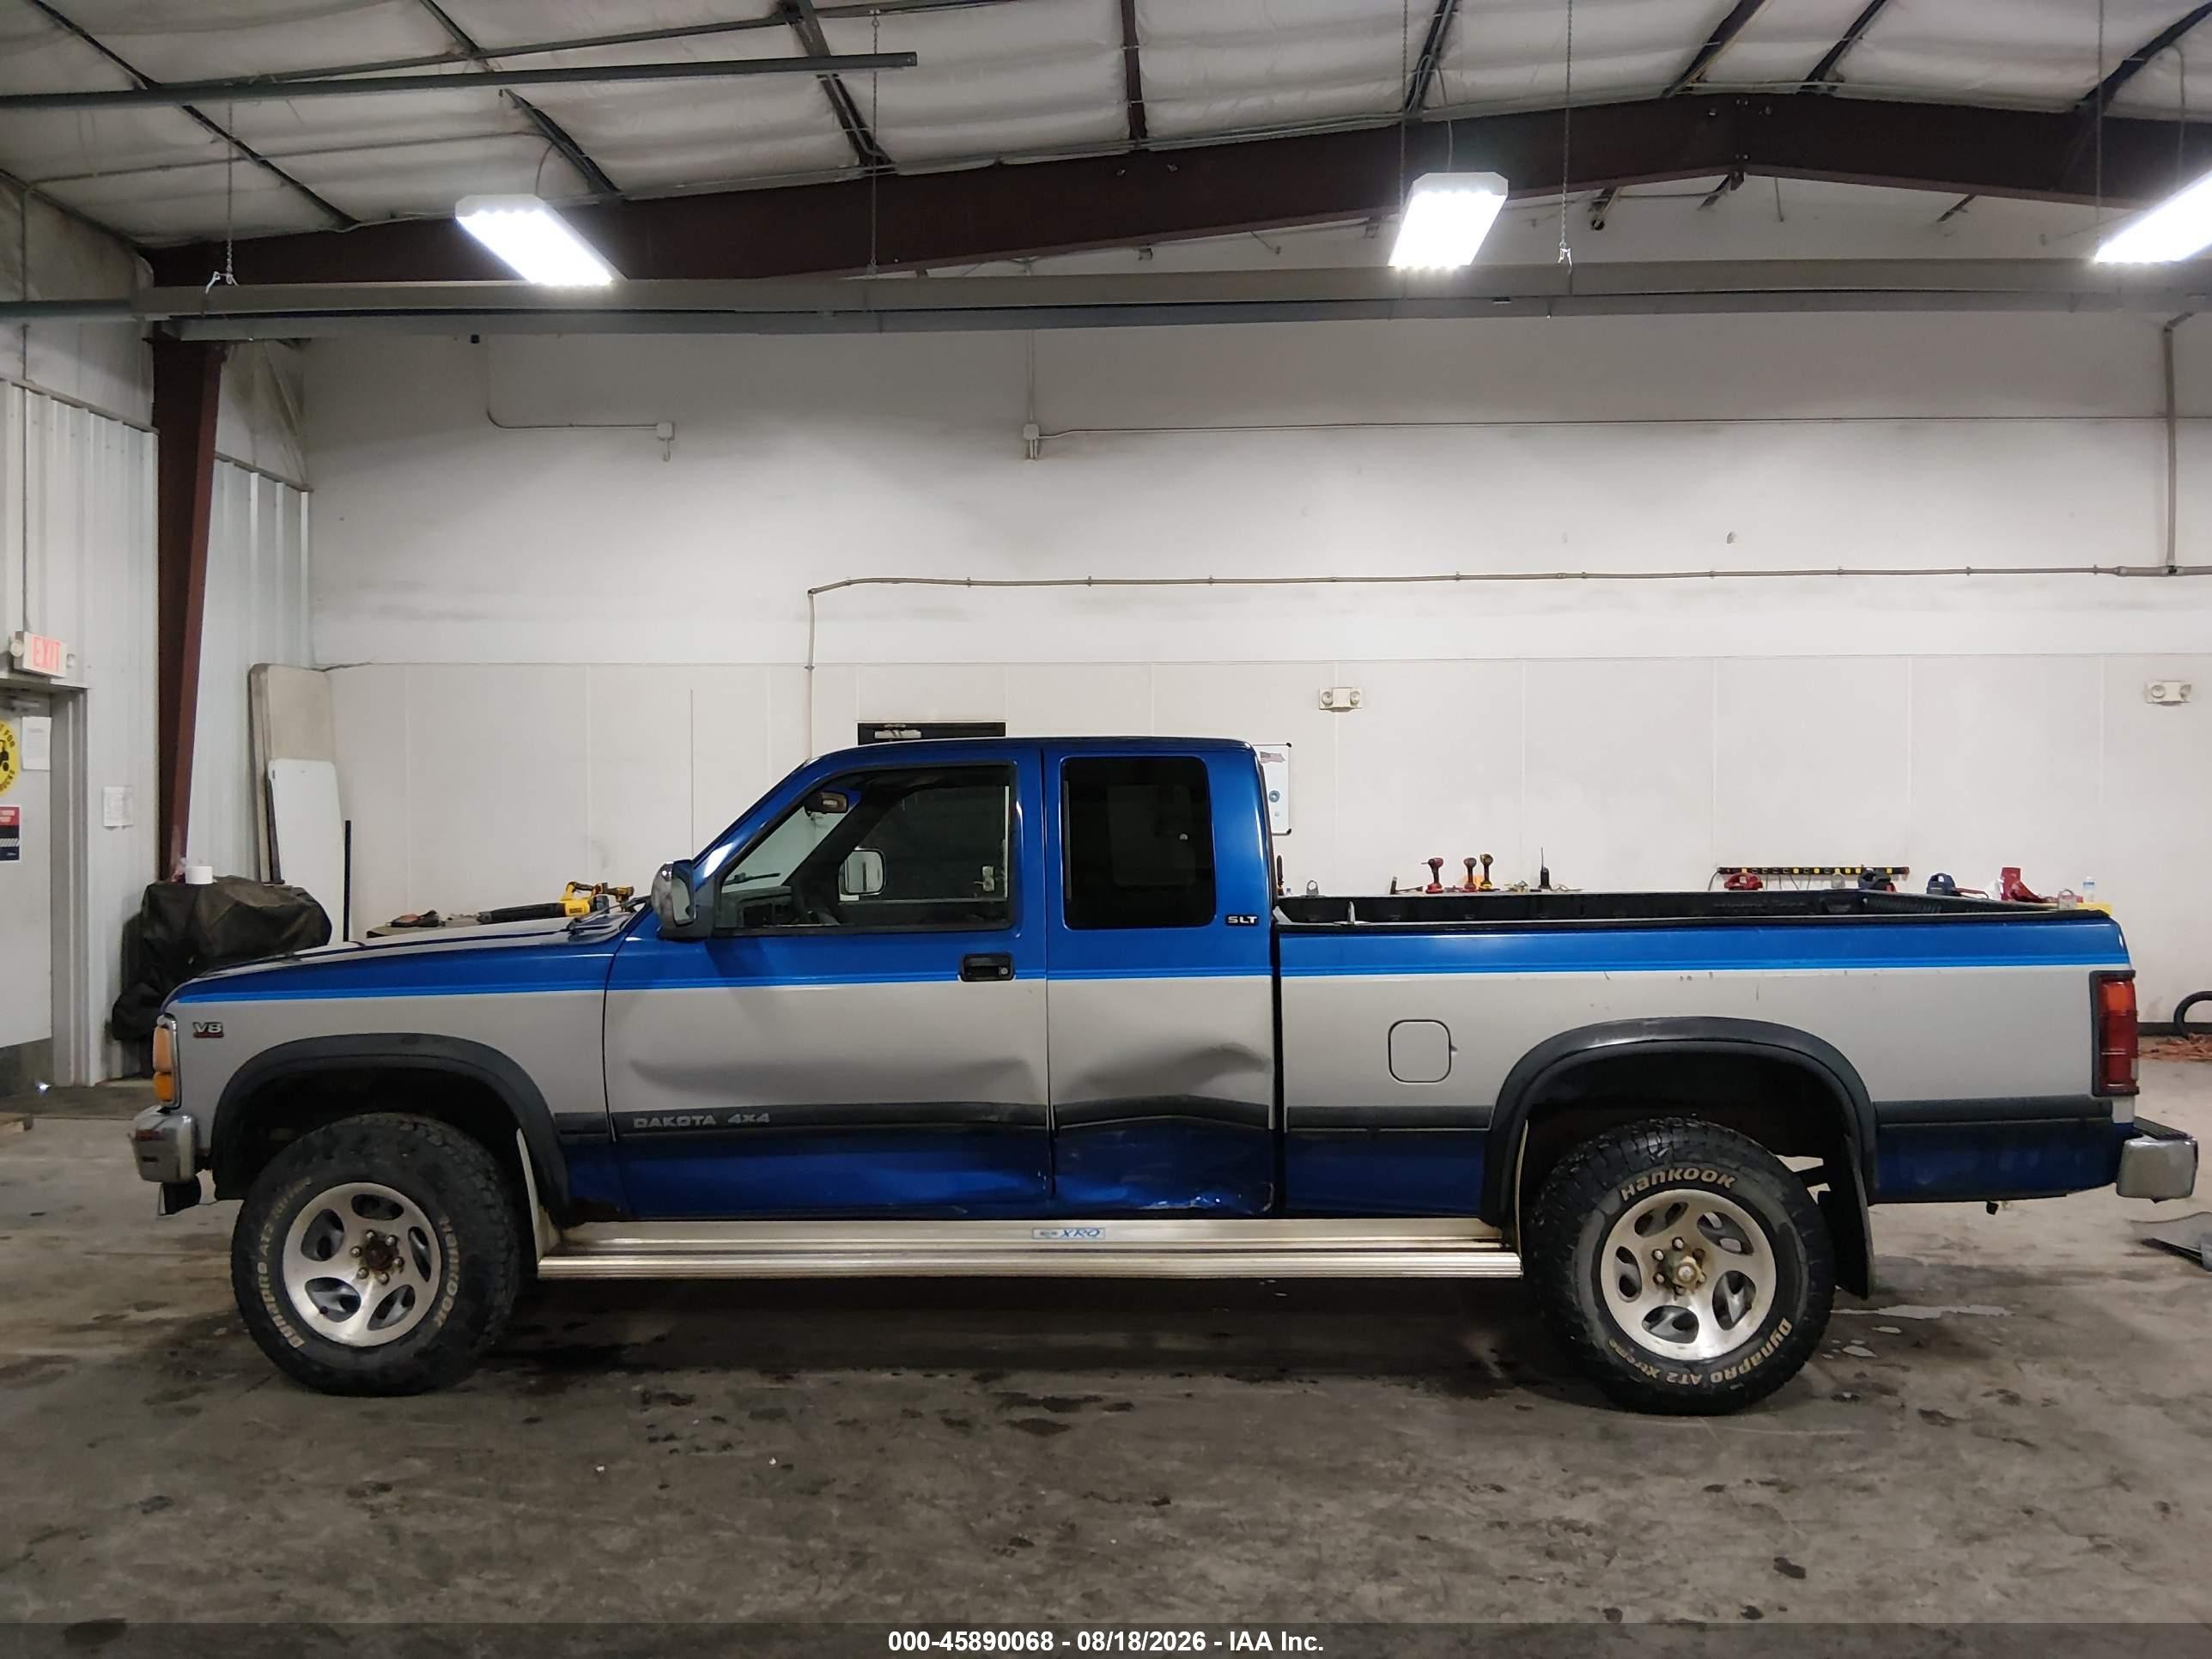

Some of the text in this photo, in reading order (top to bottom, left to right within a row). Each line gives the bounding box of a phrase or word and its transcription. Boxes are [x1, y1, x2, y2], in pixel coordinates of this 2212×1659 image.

[32, 635, 61, 672] EXIT
[1228, 915, 1258, 924] SLT
[192, 1022, 223, 1033] V8
[633, 1115, 717, 1128] DAKOTA
[1666, 1371, 1705, 1386] AT2
